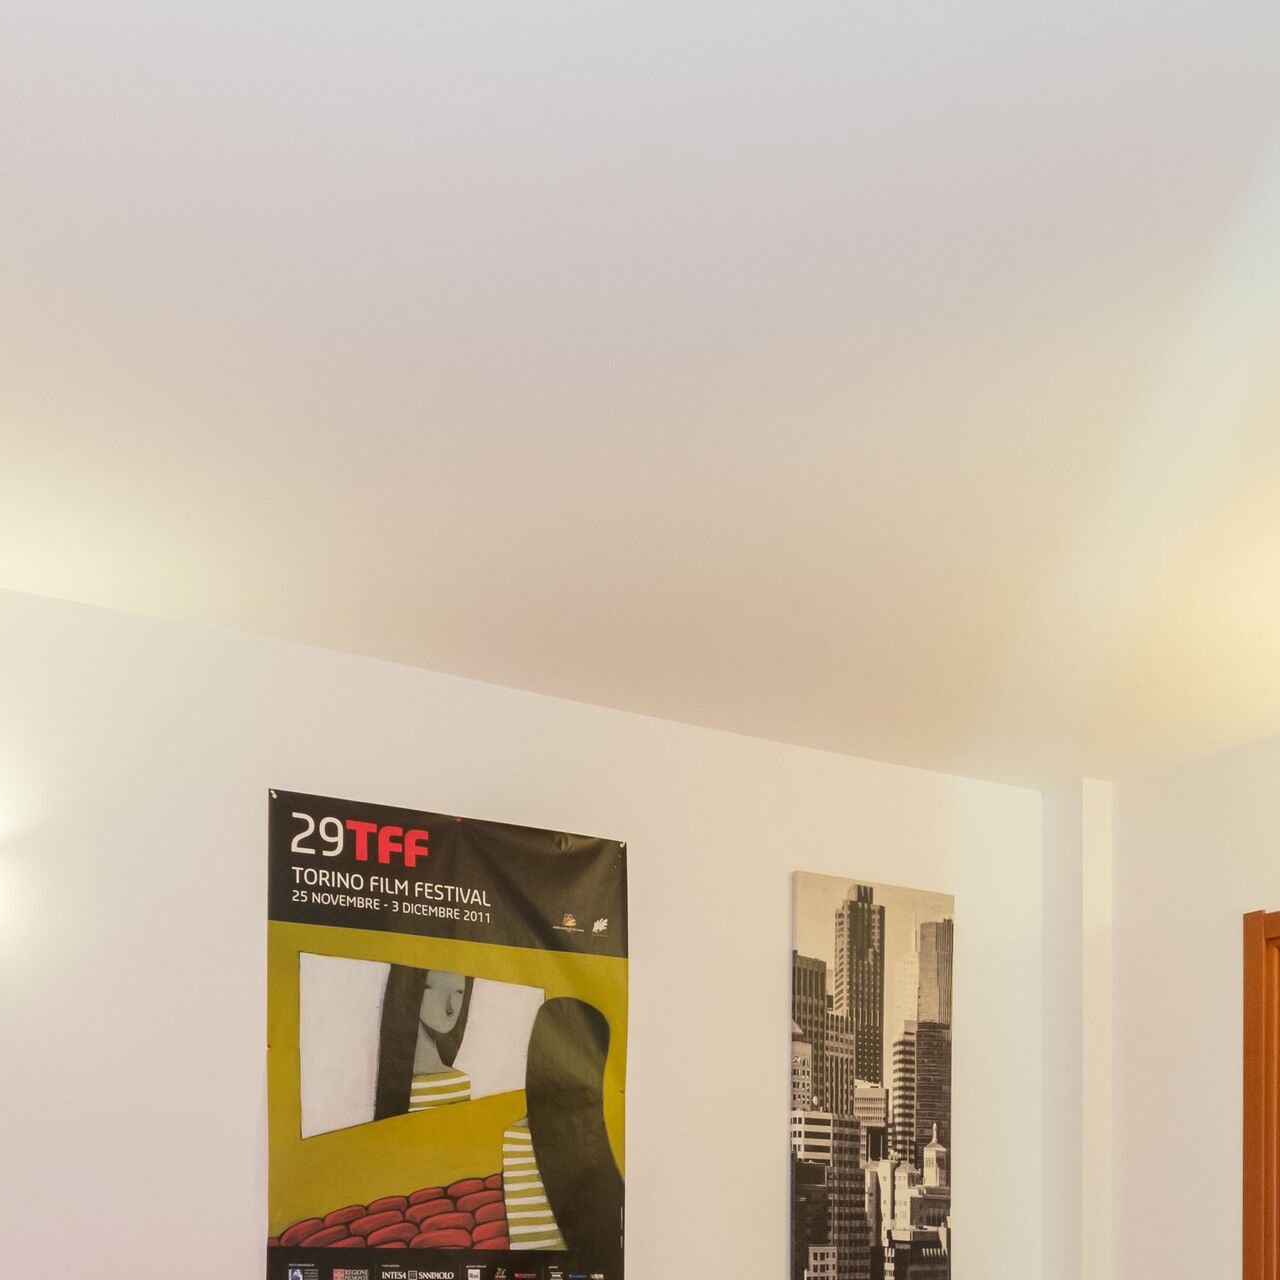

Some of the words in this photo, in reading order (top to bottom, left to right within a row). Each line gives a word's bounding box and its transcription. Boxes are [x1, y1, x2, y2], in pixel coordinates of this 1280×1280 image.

[291, 866, 365, 890] TORINO
[370, 876, 409, 897] FILM
[414, 881, 491, 907] FESTIVAL
[292, 890, 308, 903] 25
[311, 892, 380, 910] NOVEMBRE
[392, 901, 399, 912] 3
[402, 902, 460, 920] DICEMBRE
[463, 910, 491, 924] 2011
[381, 1271, 406, 1279] INTESA
